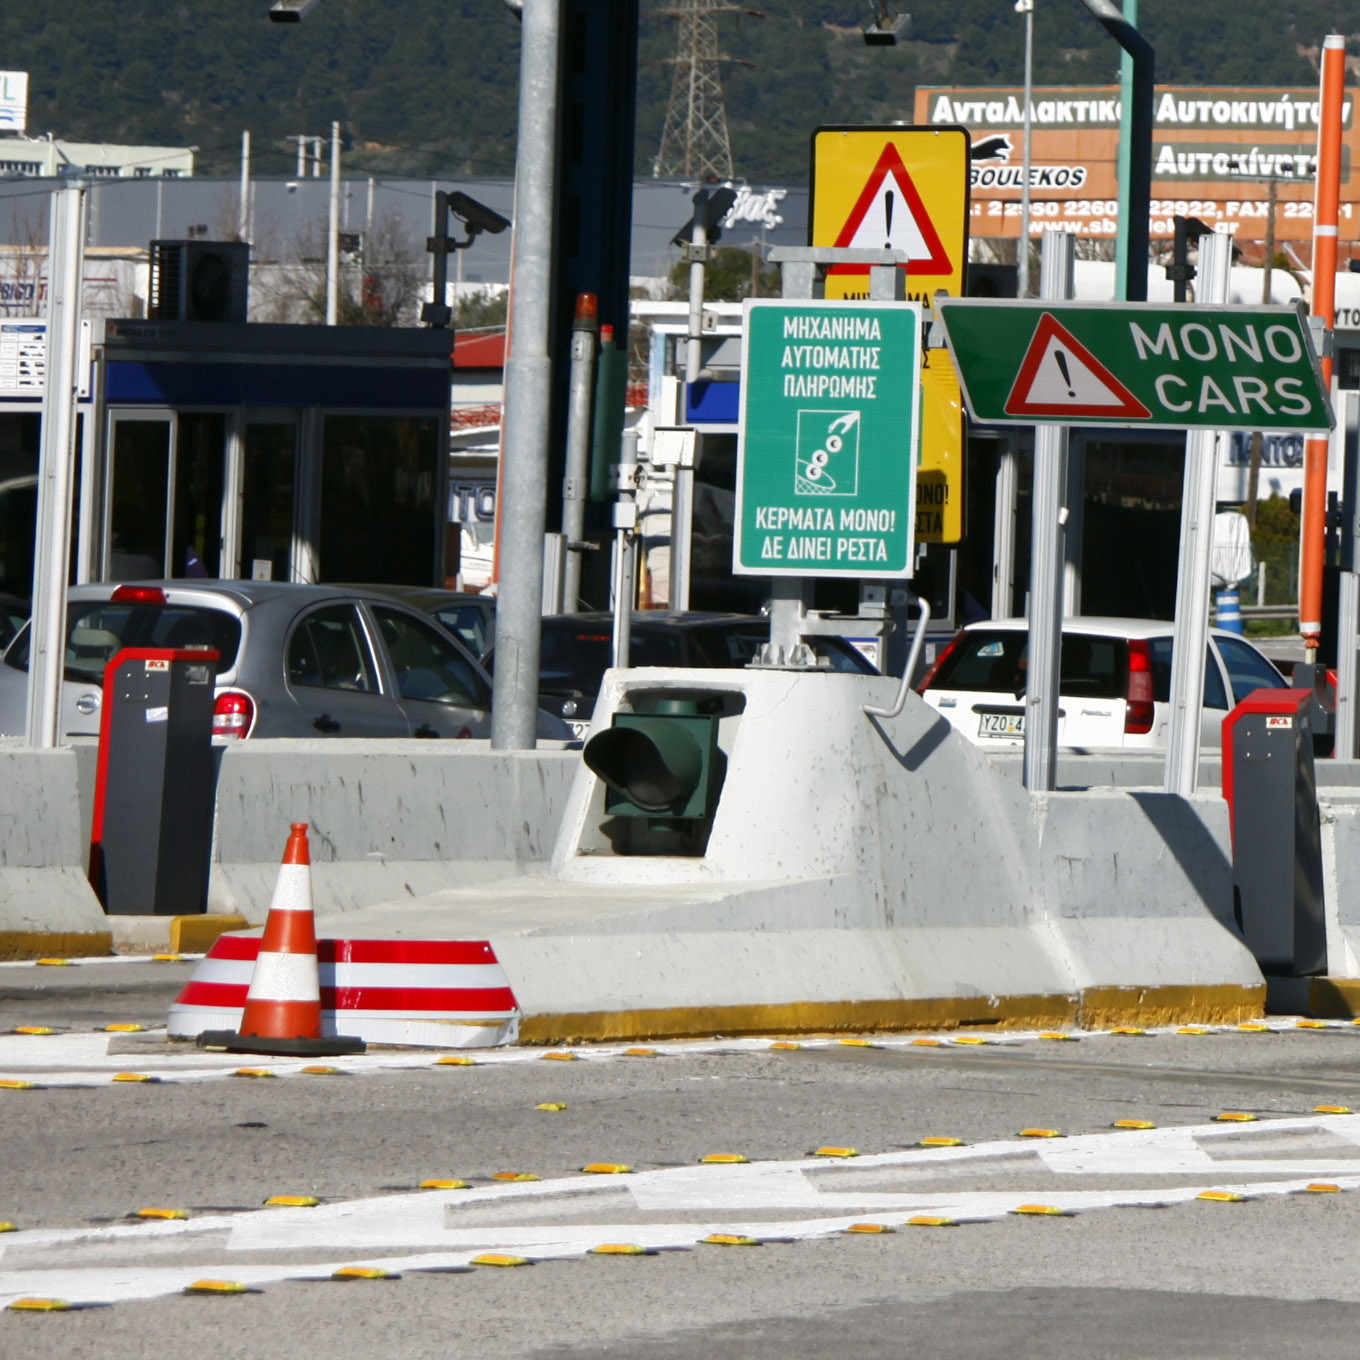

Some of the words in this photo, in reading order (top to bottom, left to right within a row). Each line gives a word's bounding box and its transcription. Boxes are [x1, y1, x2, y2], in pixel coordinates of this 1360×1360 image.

[783, 316, 881, 340] ΜΗΧΑΝΗΜΑ
[781, 346, 880, 369] ΑΥΤΟΜΑΤΗΣ
[783, 375, 877, 398] ΠΛΗΡΩΜΗΣ
[1154, 374, 1312, 415] CARS
[755, 507, 834, 530] ΚΕΡΜΑΤΑ
[839, 509, 896, 531] ΜΟΝΟ!
[760, 537, 782, 558] ΔΕ
[787, 537, 831, 559] ΔΙΝΕΙ
[836, 538, 888, 561] ΡΕΣΤΑ
